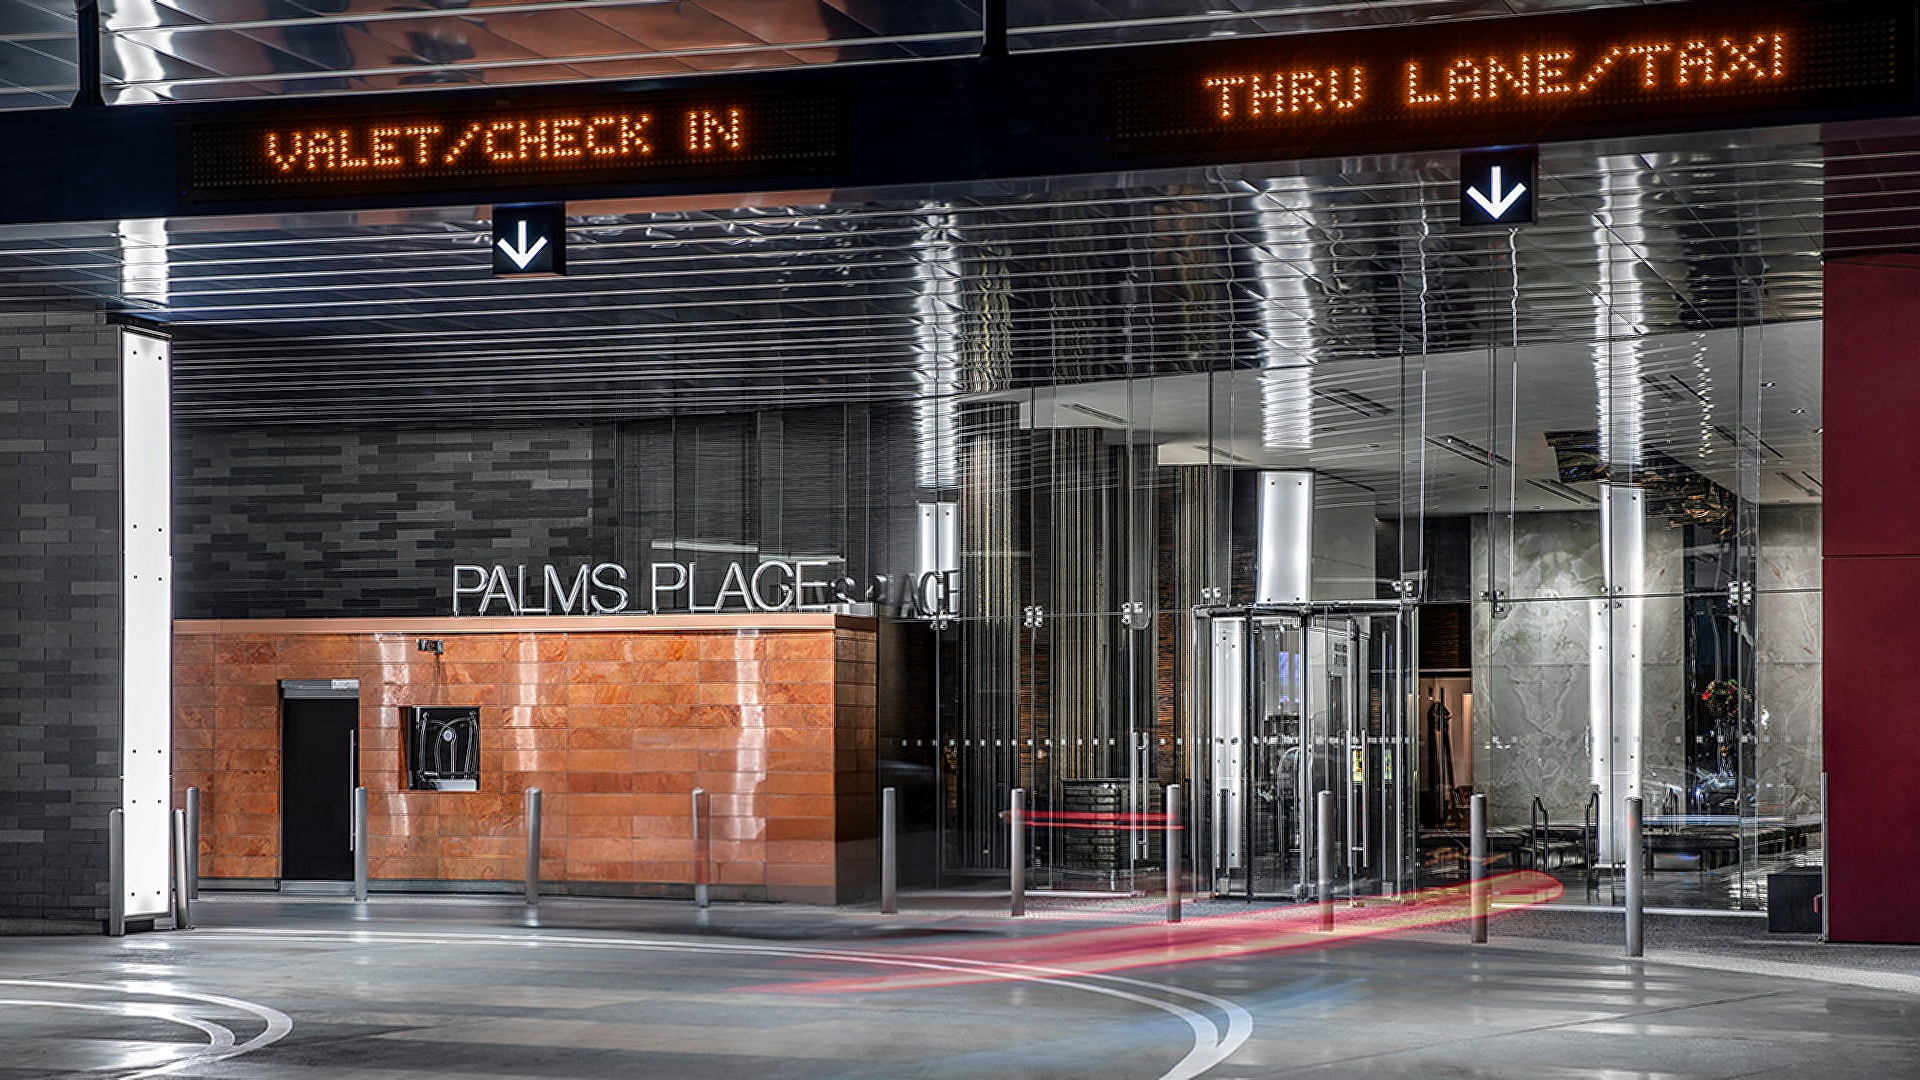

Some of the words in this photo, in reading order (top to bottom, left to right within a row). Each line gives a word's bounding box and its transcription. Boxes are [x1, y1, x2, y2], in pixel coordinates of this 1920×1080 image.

[1206, 68, 1362, 117] THRU
[1408, 34, 1783, 104] LANE/TAXI
[268, 115, 650, 170] VALET/CHECK
[690, 109, 740, 151] IN
[451, 563, 628, 614] PALMS
[651, 560, 831, 613] PLACE
